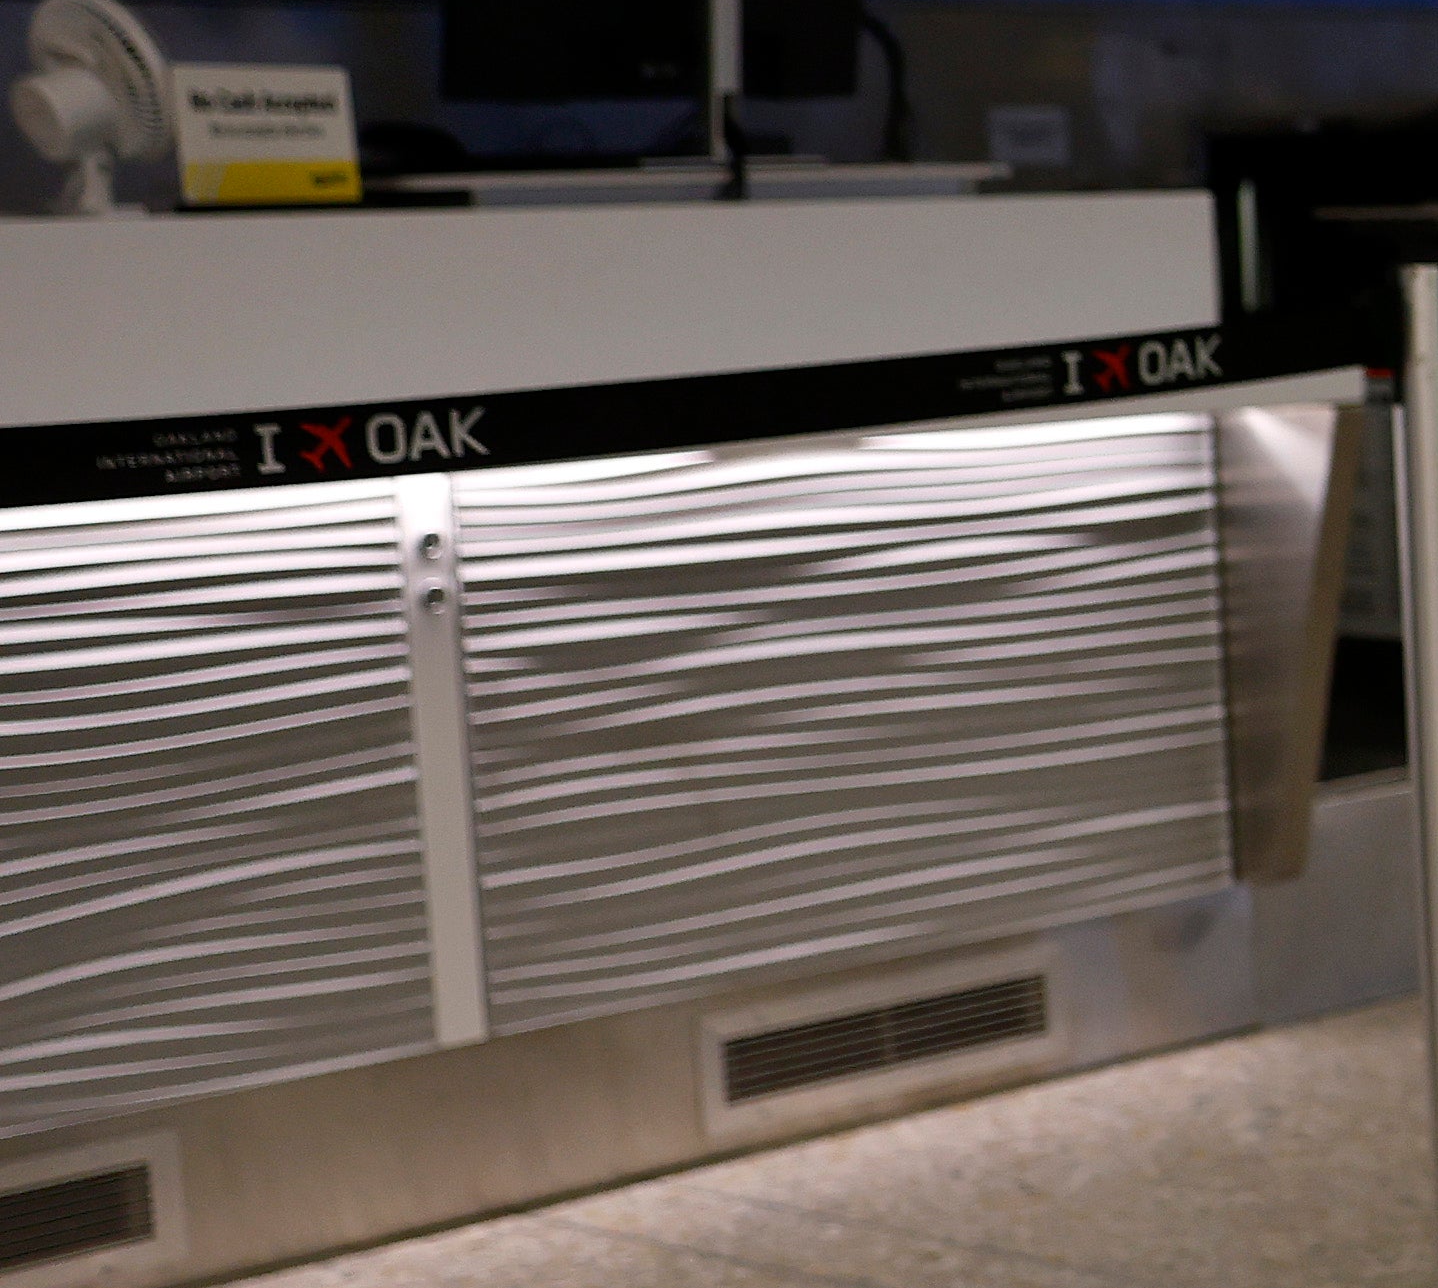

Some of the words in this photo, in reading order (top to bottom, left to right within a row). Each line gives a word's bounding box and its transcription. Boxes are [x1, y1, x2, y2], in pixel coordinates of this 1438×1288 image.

[1137, 332, 1223, 387] OAK
[252, 422, 287, 476] I
[364, 406, 492, 465] OAK
